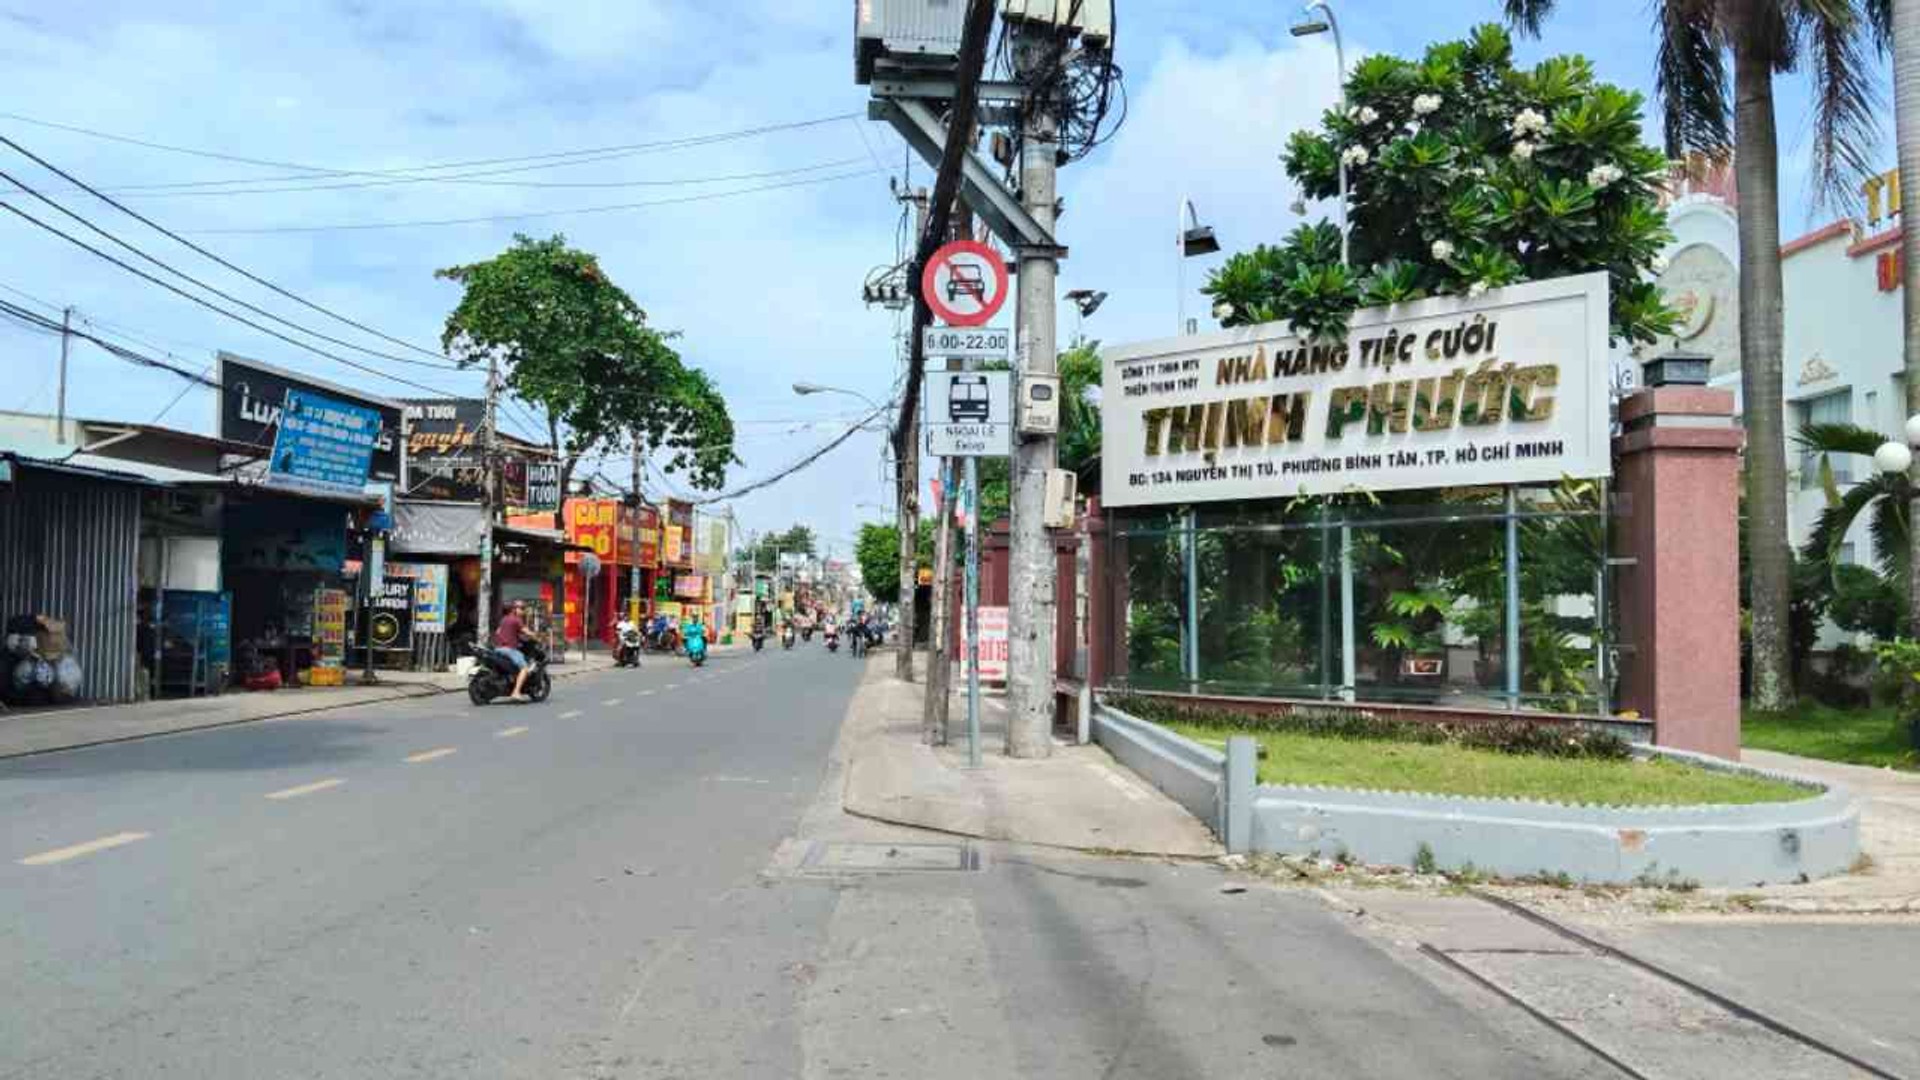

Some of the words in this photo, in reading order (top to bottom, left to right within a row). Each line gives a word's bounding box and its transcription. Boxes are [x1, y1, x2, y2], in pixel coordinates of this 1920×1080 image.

[1216, 344, 1268, 386] NHÀ
[1273, 342, 1348, 378] HÀNG
[1359, 328, 1416, 373] TIỆC
[1424, 313, 1498, 360] CƯỚI
[1142, 389, 1312, 464] THỊNH
[1325, 358, 1560, 438] PHƯỚC
[1176, 463, 1227, 481] NGUYỄN
[1231, 464, 1252, 480] THỊ
[1282, 455, 1342, 475] PHƯỜNG
[1455, 441, 1477, 464] HỒ
[1481, 441, 1511, 461] CHÍ
[1515, 440, 1563, 458] MINH
